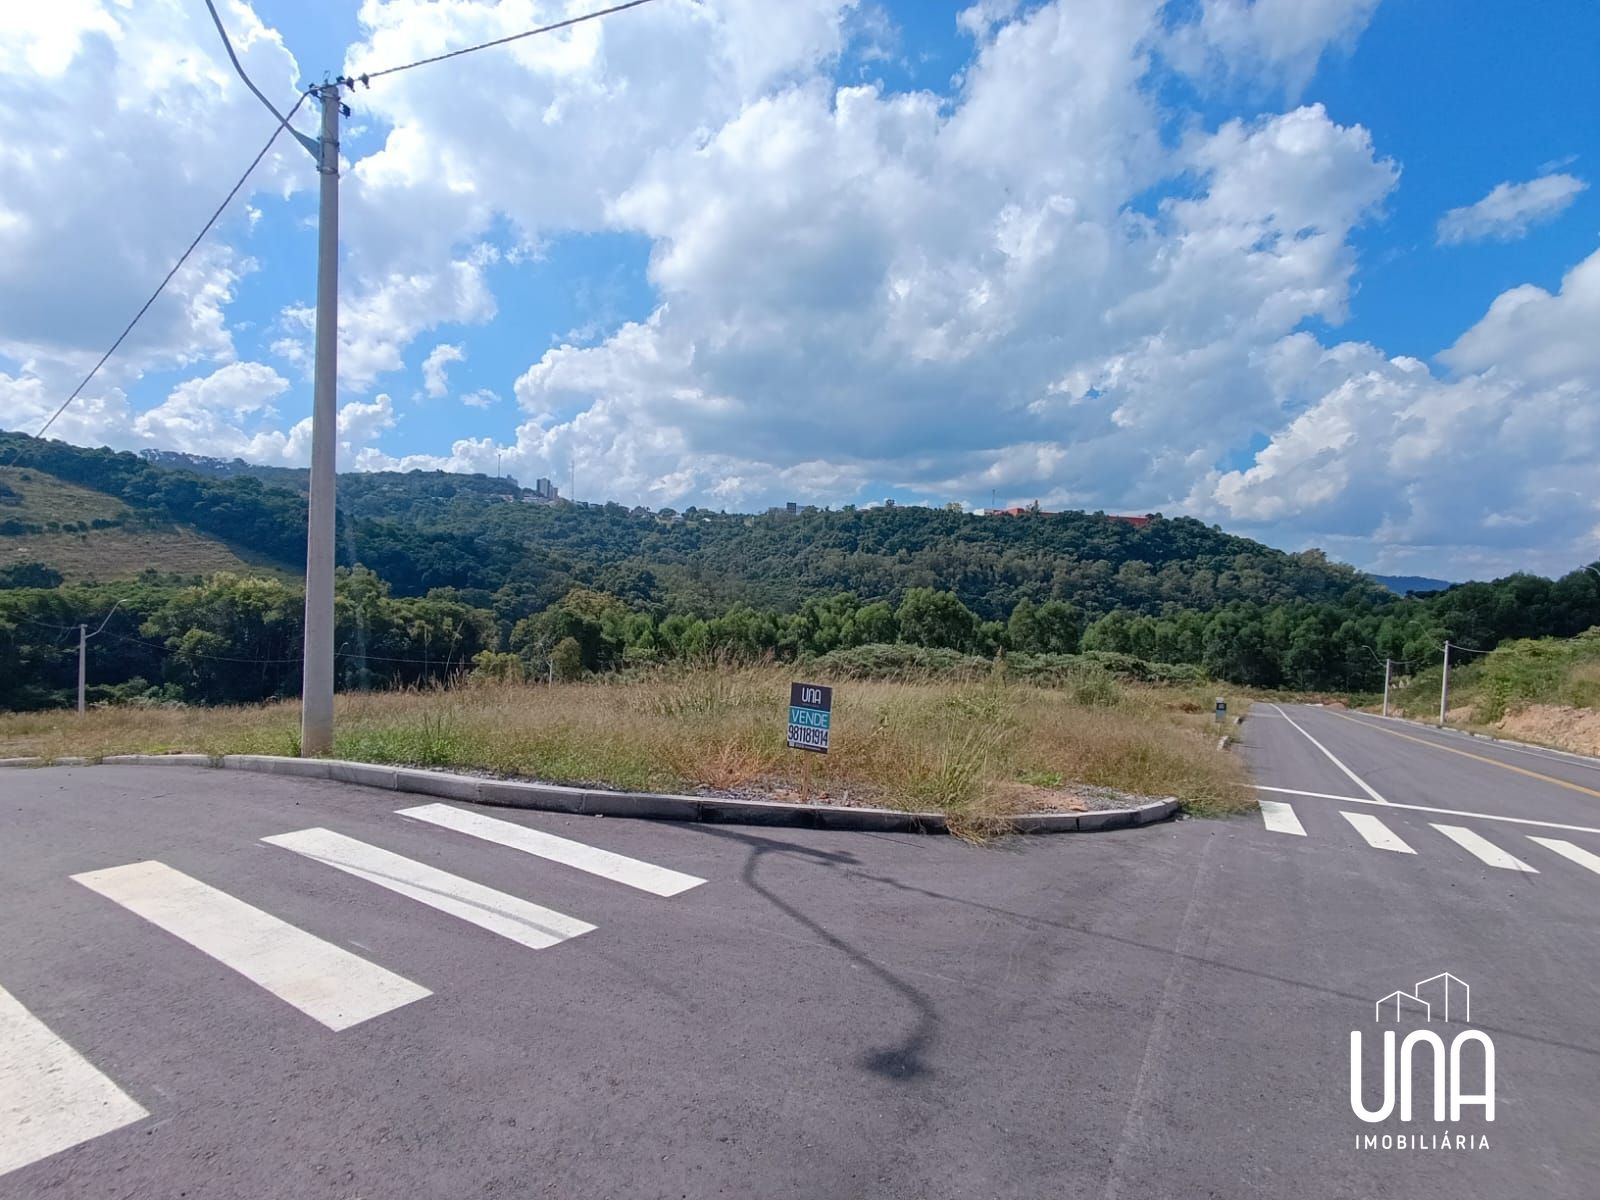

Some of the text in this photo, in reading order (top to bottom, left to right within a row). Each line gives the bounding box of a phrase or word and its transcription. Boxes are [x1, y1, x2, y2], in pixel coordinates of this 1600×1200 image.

[801, 687, 821, 705] UNA
[791, 708, 828, 728] VENDE
[788, 724, 828, 746] 981181914
